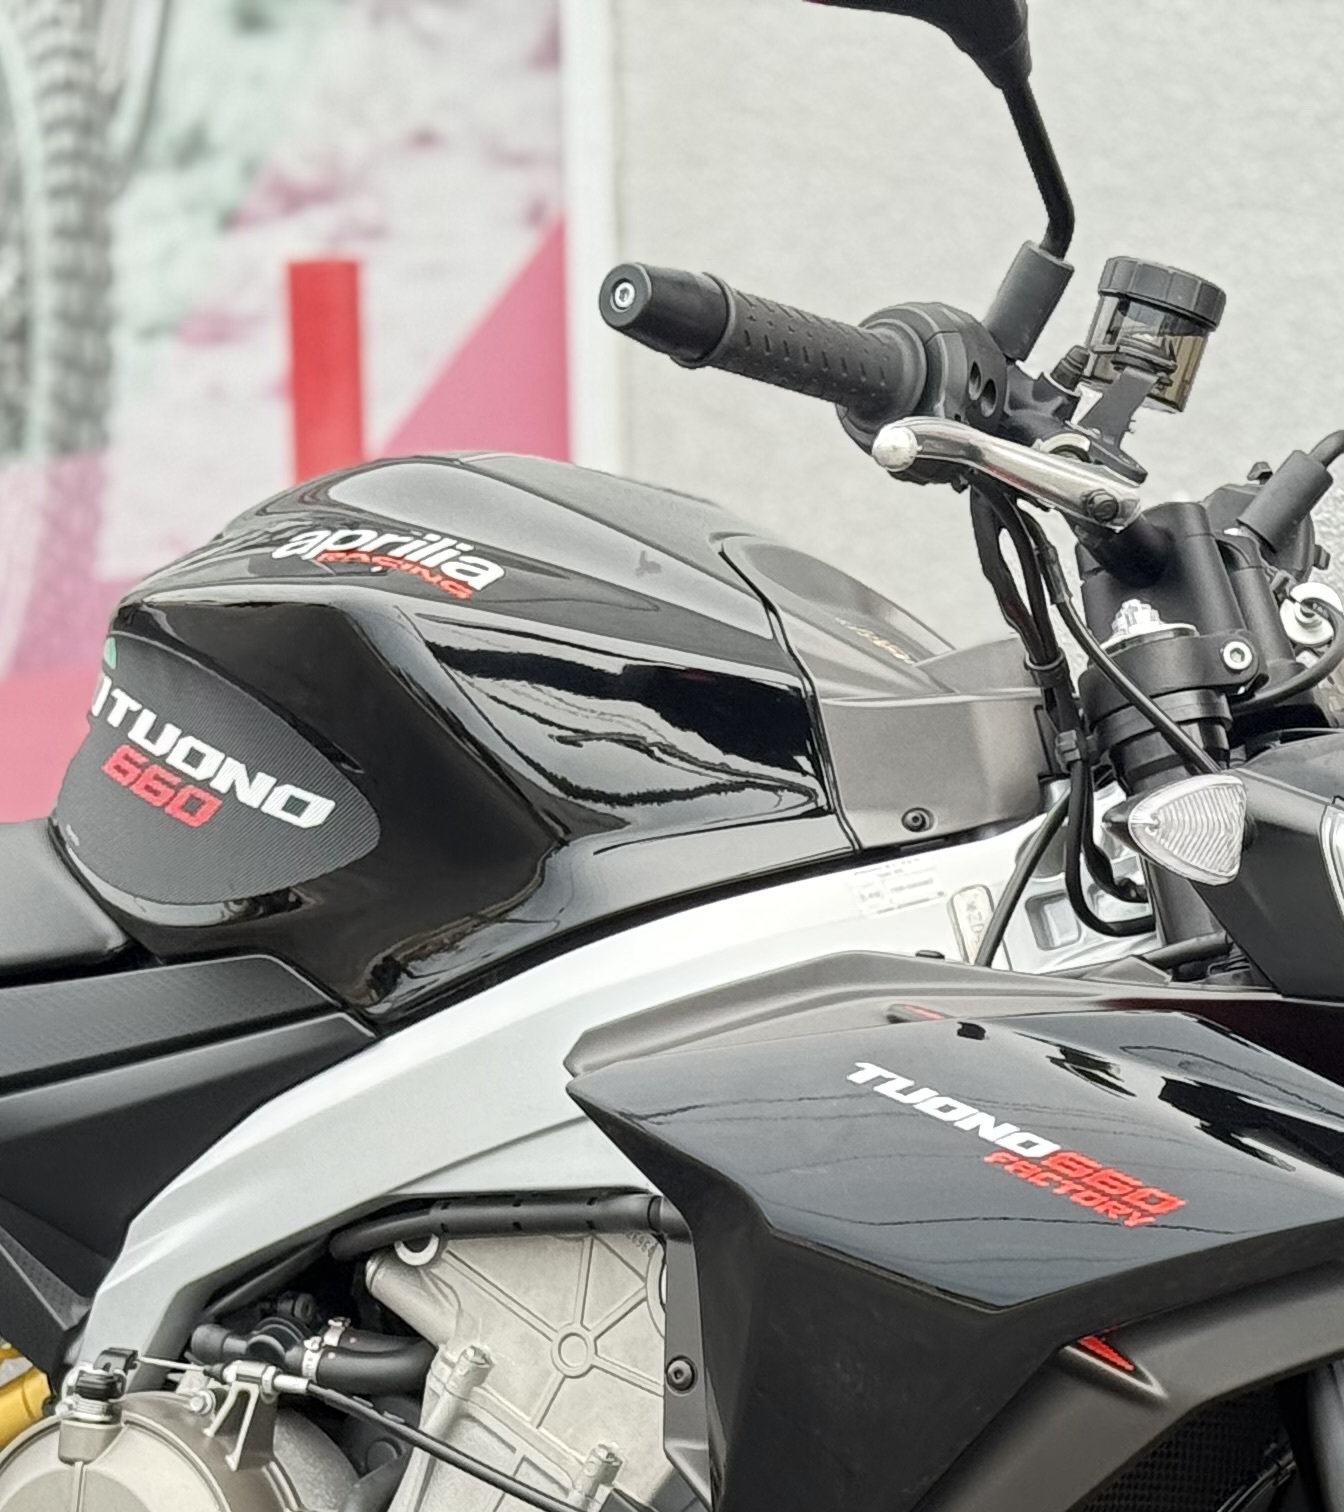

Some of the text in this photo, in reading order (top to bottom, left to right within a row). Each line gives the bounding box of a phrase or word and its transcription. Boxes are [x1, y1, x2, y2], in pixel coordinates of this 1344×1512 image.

[272, 529, 505, 591] aprilia
[315, 552, 473, 600] RACING
[101, 744, 223, 828] 660
[107, 688, 336, 828] TUONO
[846, 1061, 1188, 1216] TUONO 660
[983, 1151, 1156, 1229] FACTORY
